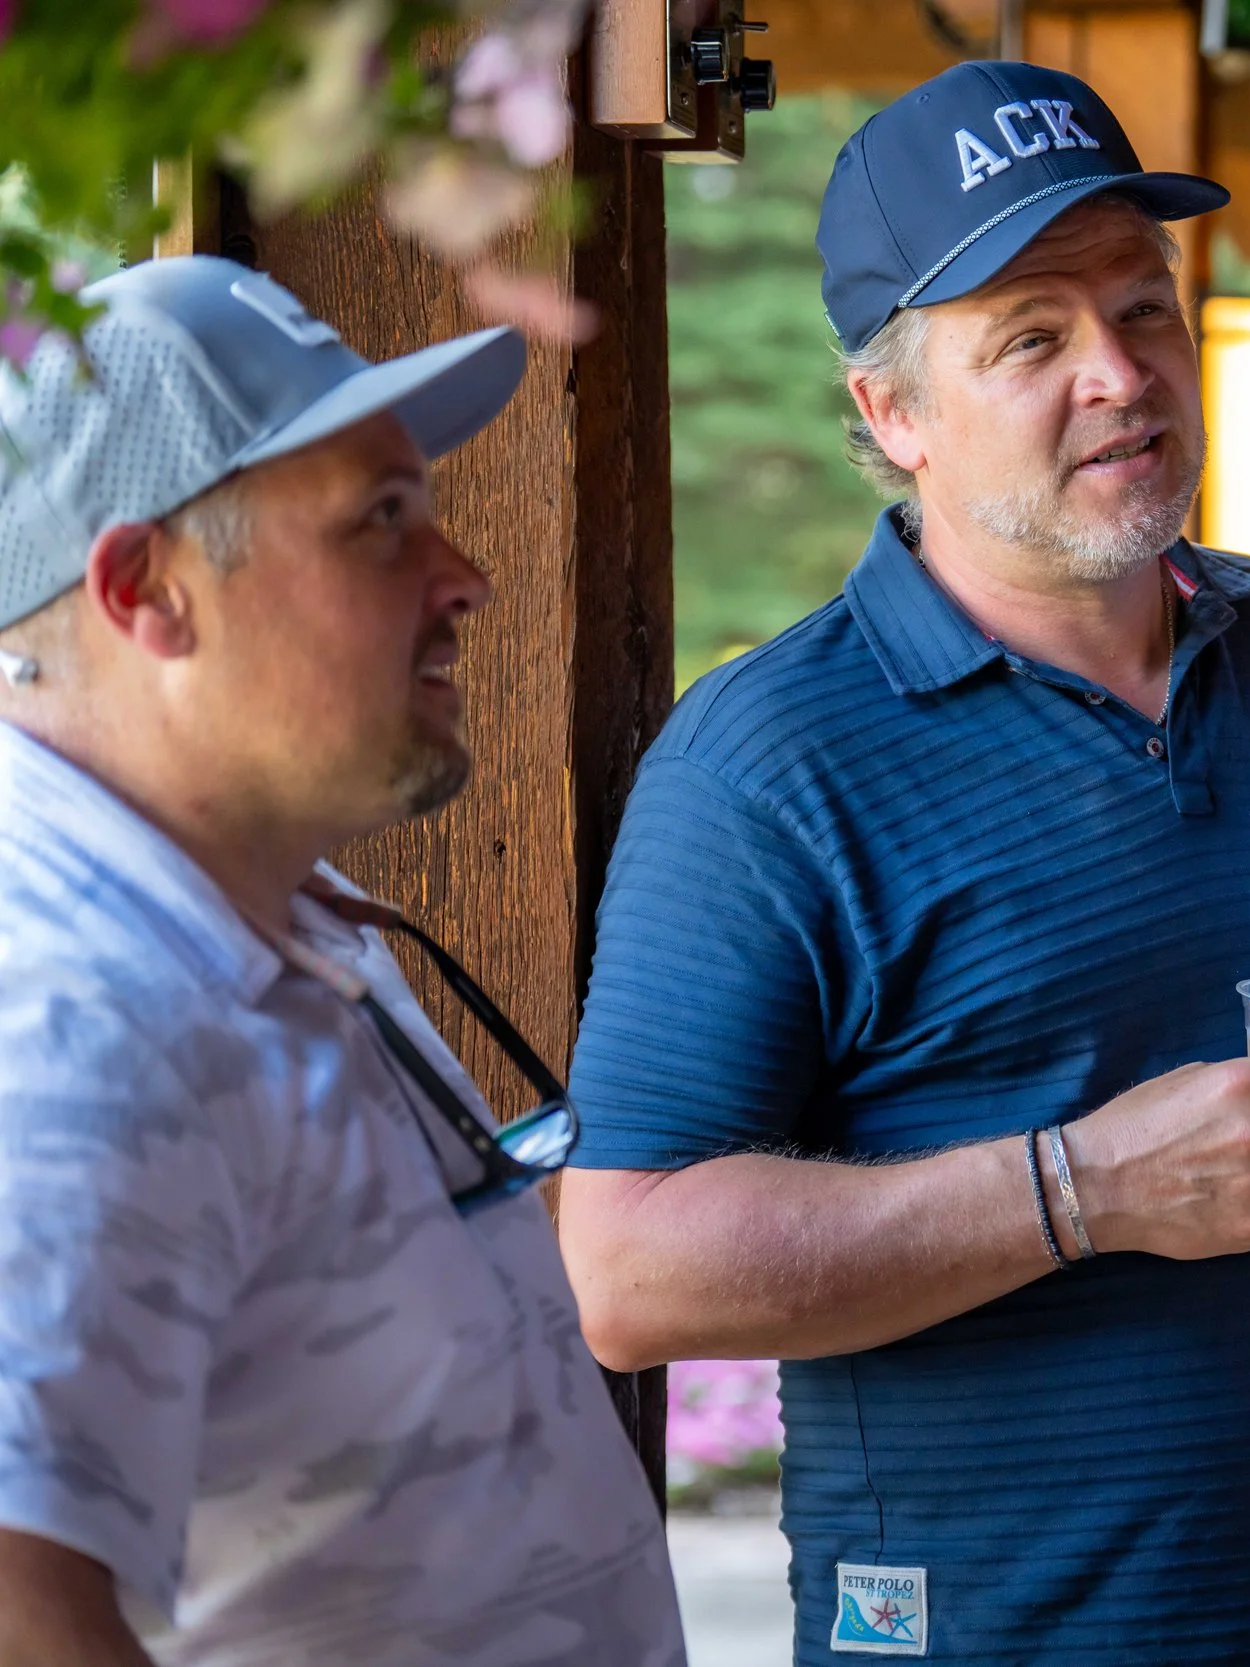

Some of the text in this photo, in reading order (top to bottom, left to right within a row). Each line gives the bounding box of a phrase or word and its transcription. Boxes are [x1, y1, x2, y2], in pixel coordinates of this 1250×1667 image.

[954, 99, 1100, 193] ACK
[843, 1575, 914, 1591] PETER POLO
[876, 1589, 914, 1599] TROPEZ
